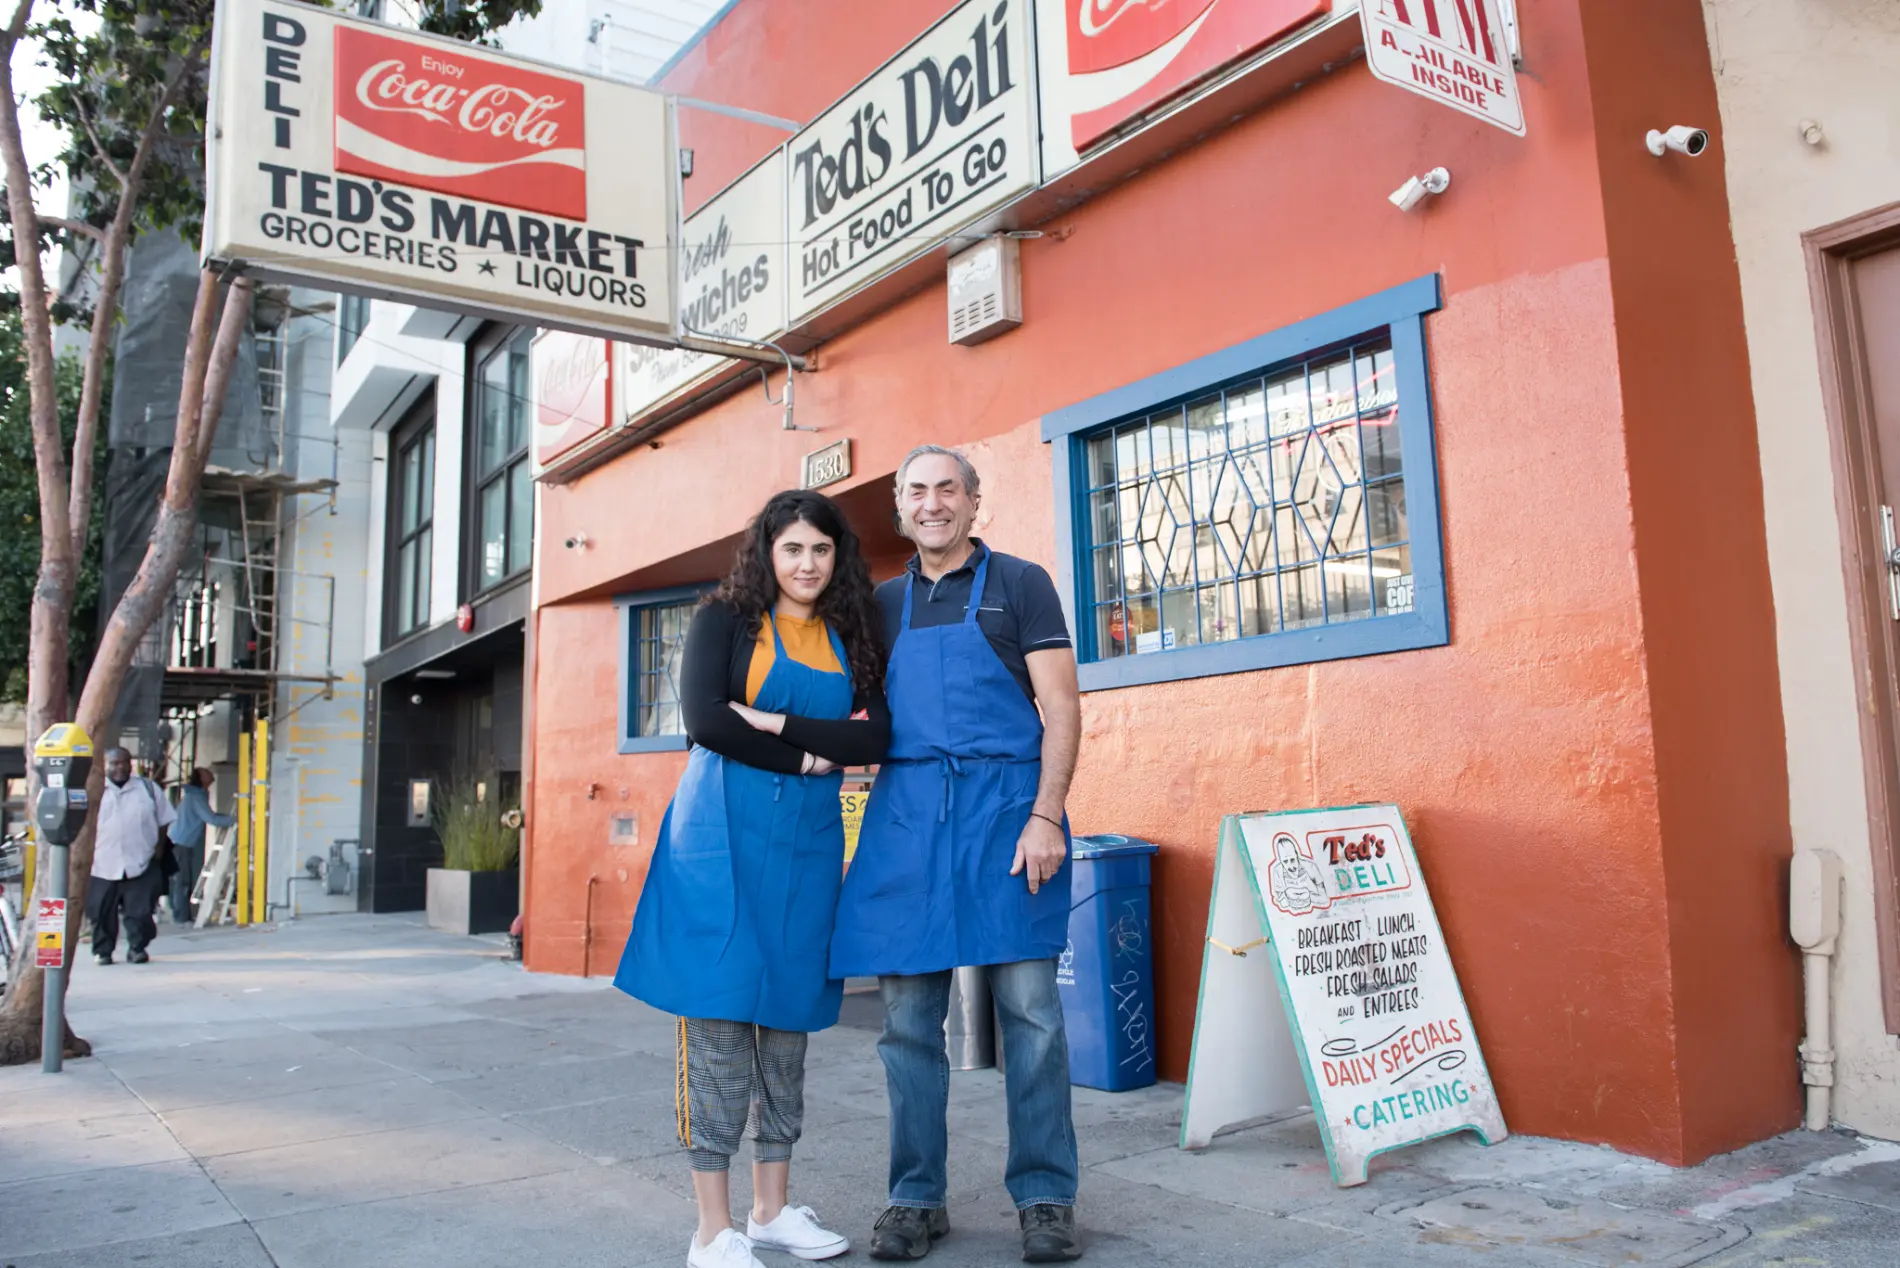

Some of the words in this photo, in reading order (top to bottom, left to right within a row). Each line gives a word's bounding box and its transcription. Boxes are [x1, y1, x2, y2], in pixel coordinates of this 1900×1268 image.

[262, 12, 307, 149] DELI
[421, 54, 464, 79] Enjoy
[1381, 29, 1507, 98] AAILABLE
[1411, 63, 1489, 111] INSIDE
[355, 59, 566, 148] Coca-Cola
[793, 101, 892, 231] Ted's
[897, 0, 1017, 164] Deli
[258, 162, 416, 233] TED'S
[431, 197, 645, 279] MARKET
[802, 237, 840, 288] Hot
[848, 187, 913, 262] Food
[921, 167, 953, 213] To
[963, 137, 1007, 187] Go
[259, 212, 458, 273] GROCERIES
[515, 260, 646, 308] LIQUORS
[682, 213, 733, 284] resh
[807, 451, 844, 487] 1530
[1322, 832, 1387, 866] Ted's
[1334, 862, 1396, 891] DELI
[1295, 951, 1333, 976] FRESH
[1336, 942, 1387, 970] ROASTED
[1391, 935, 1427, 960] MEATS
[1298, 920, 1361, 949] BREAKFAST
[1377, 912, 1415, 936] LUNCH
[1327, 971, 1367, 998] FRESH
[1373, 961, 1417, 991] SALADS
[1337, 1005, 1354, 1017] AND
[1364, 986, 1418, 1019] ENTREES
[1322, 1053, 1377, 1087] DAILY
[1380, 1018, 1463, 1074] SPECIALS
[1353, 1079, 1469, 1130] CATERING
